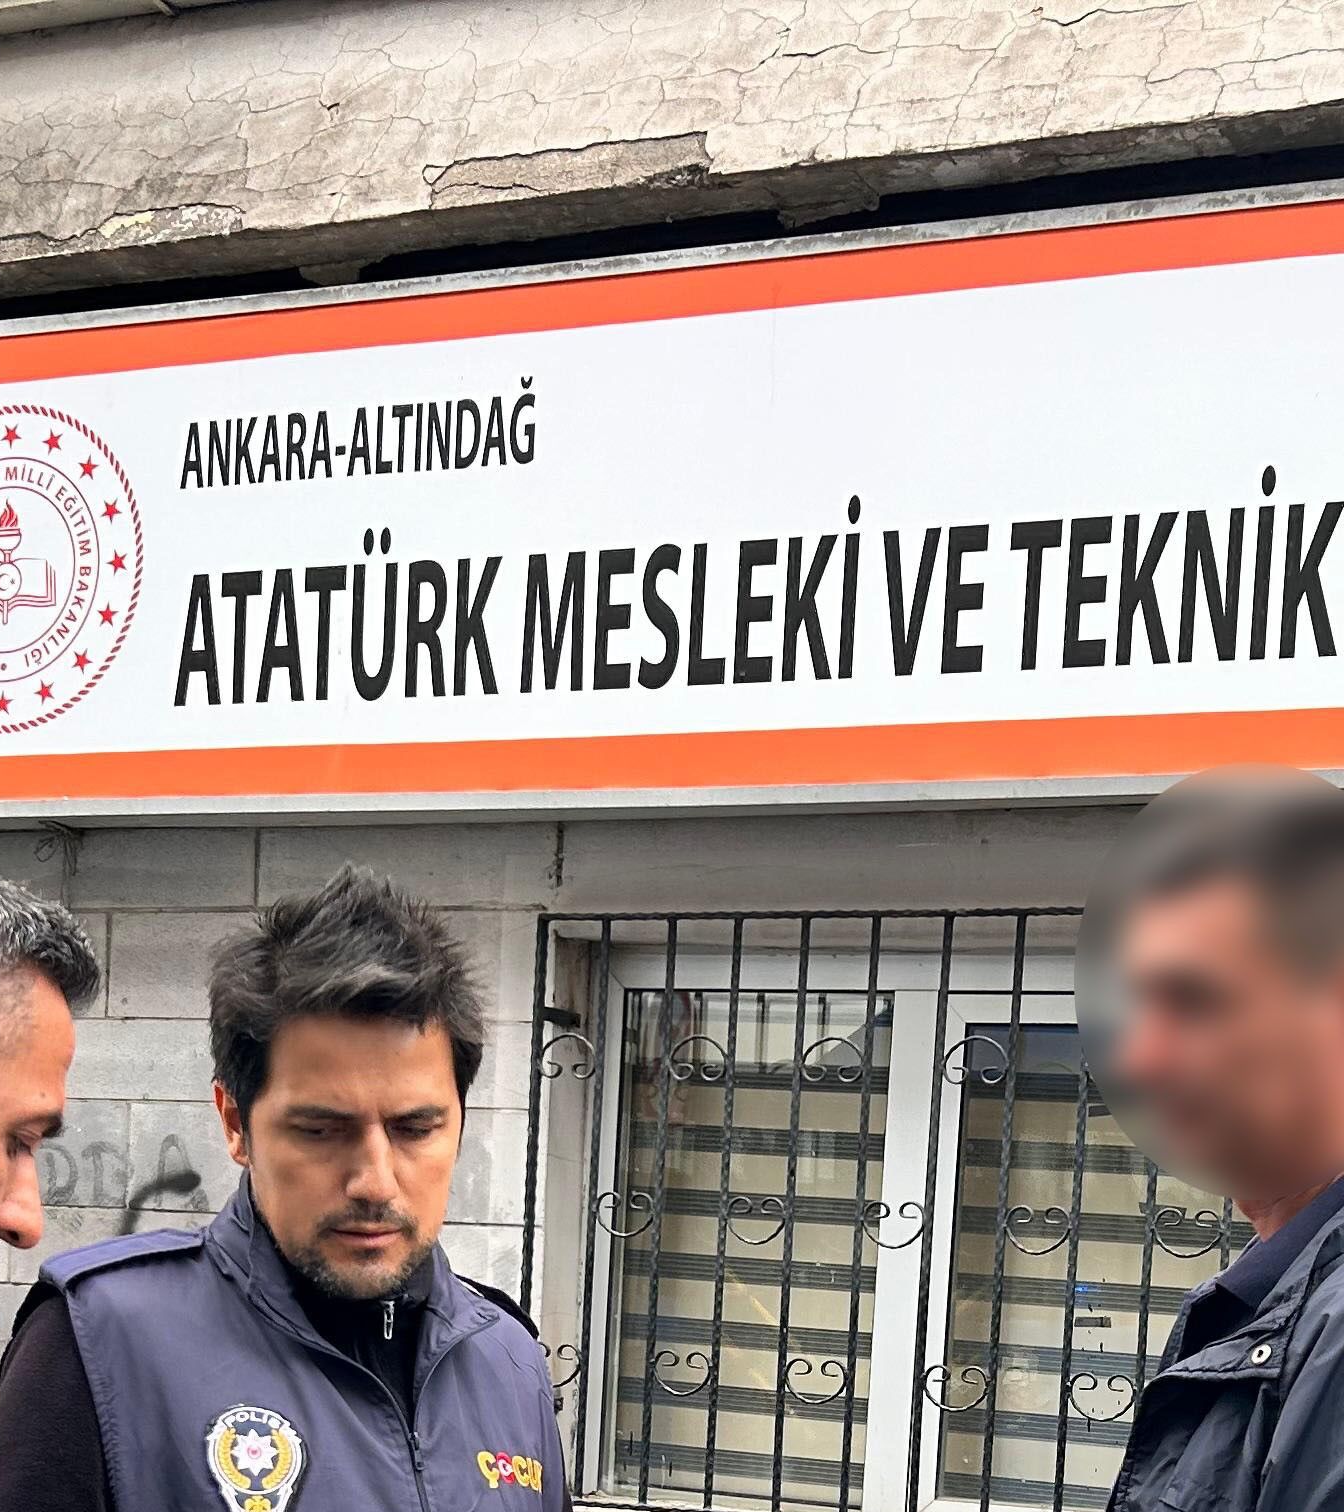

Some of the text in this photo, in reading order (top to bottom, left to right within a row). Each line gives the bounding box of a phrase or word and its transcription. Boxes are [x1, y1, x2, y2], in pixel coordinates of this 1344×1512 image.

[179, 376, 537, 490] ANKARA-ALTINDAĞ
[58, 486, 92, 557] EĞİTİM
[23, 565, 92, 668] BAKANLIĞI
[173, 527, 504, 707] ATATÜRK
[519, 494, 862, 694] MESLEKİ
[882, 523, 991, 677] VE
[476, 1450, 544, 1494] ÇOCU
